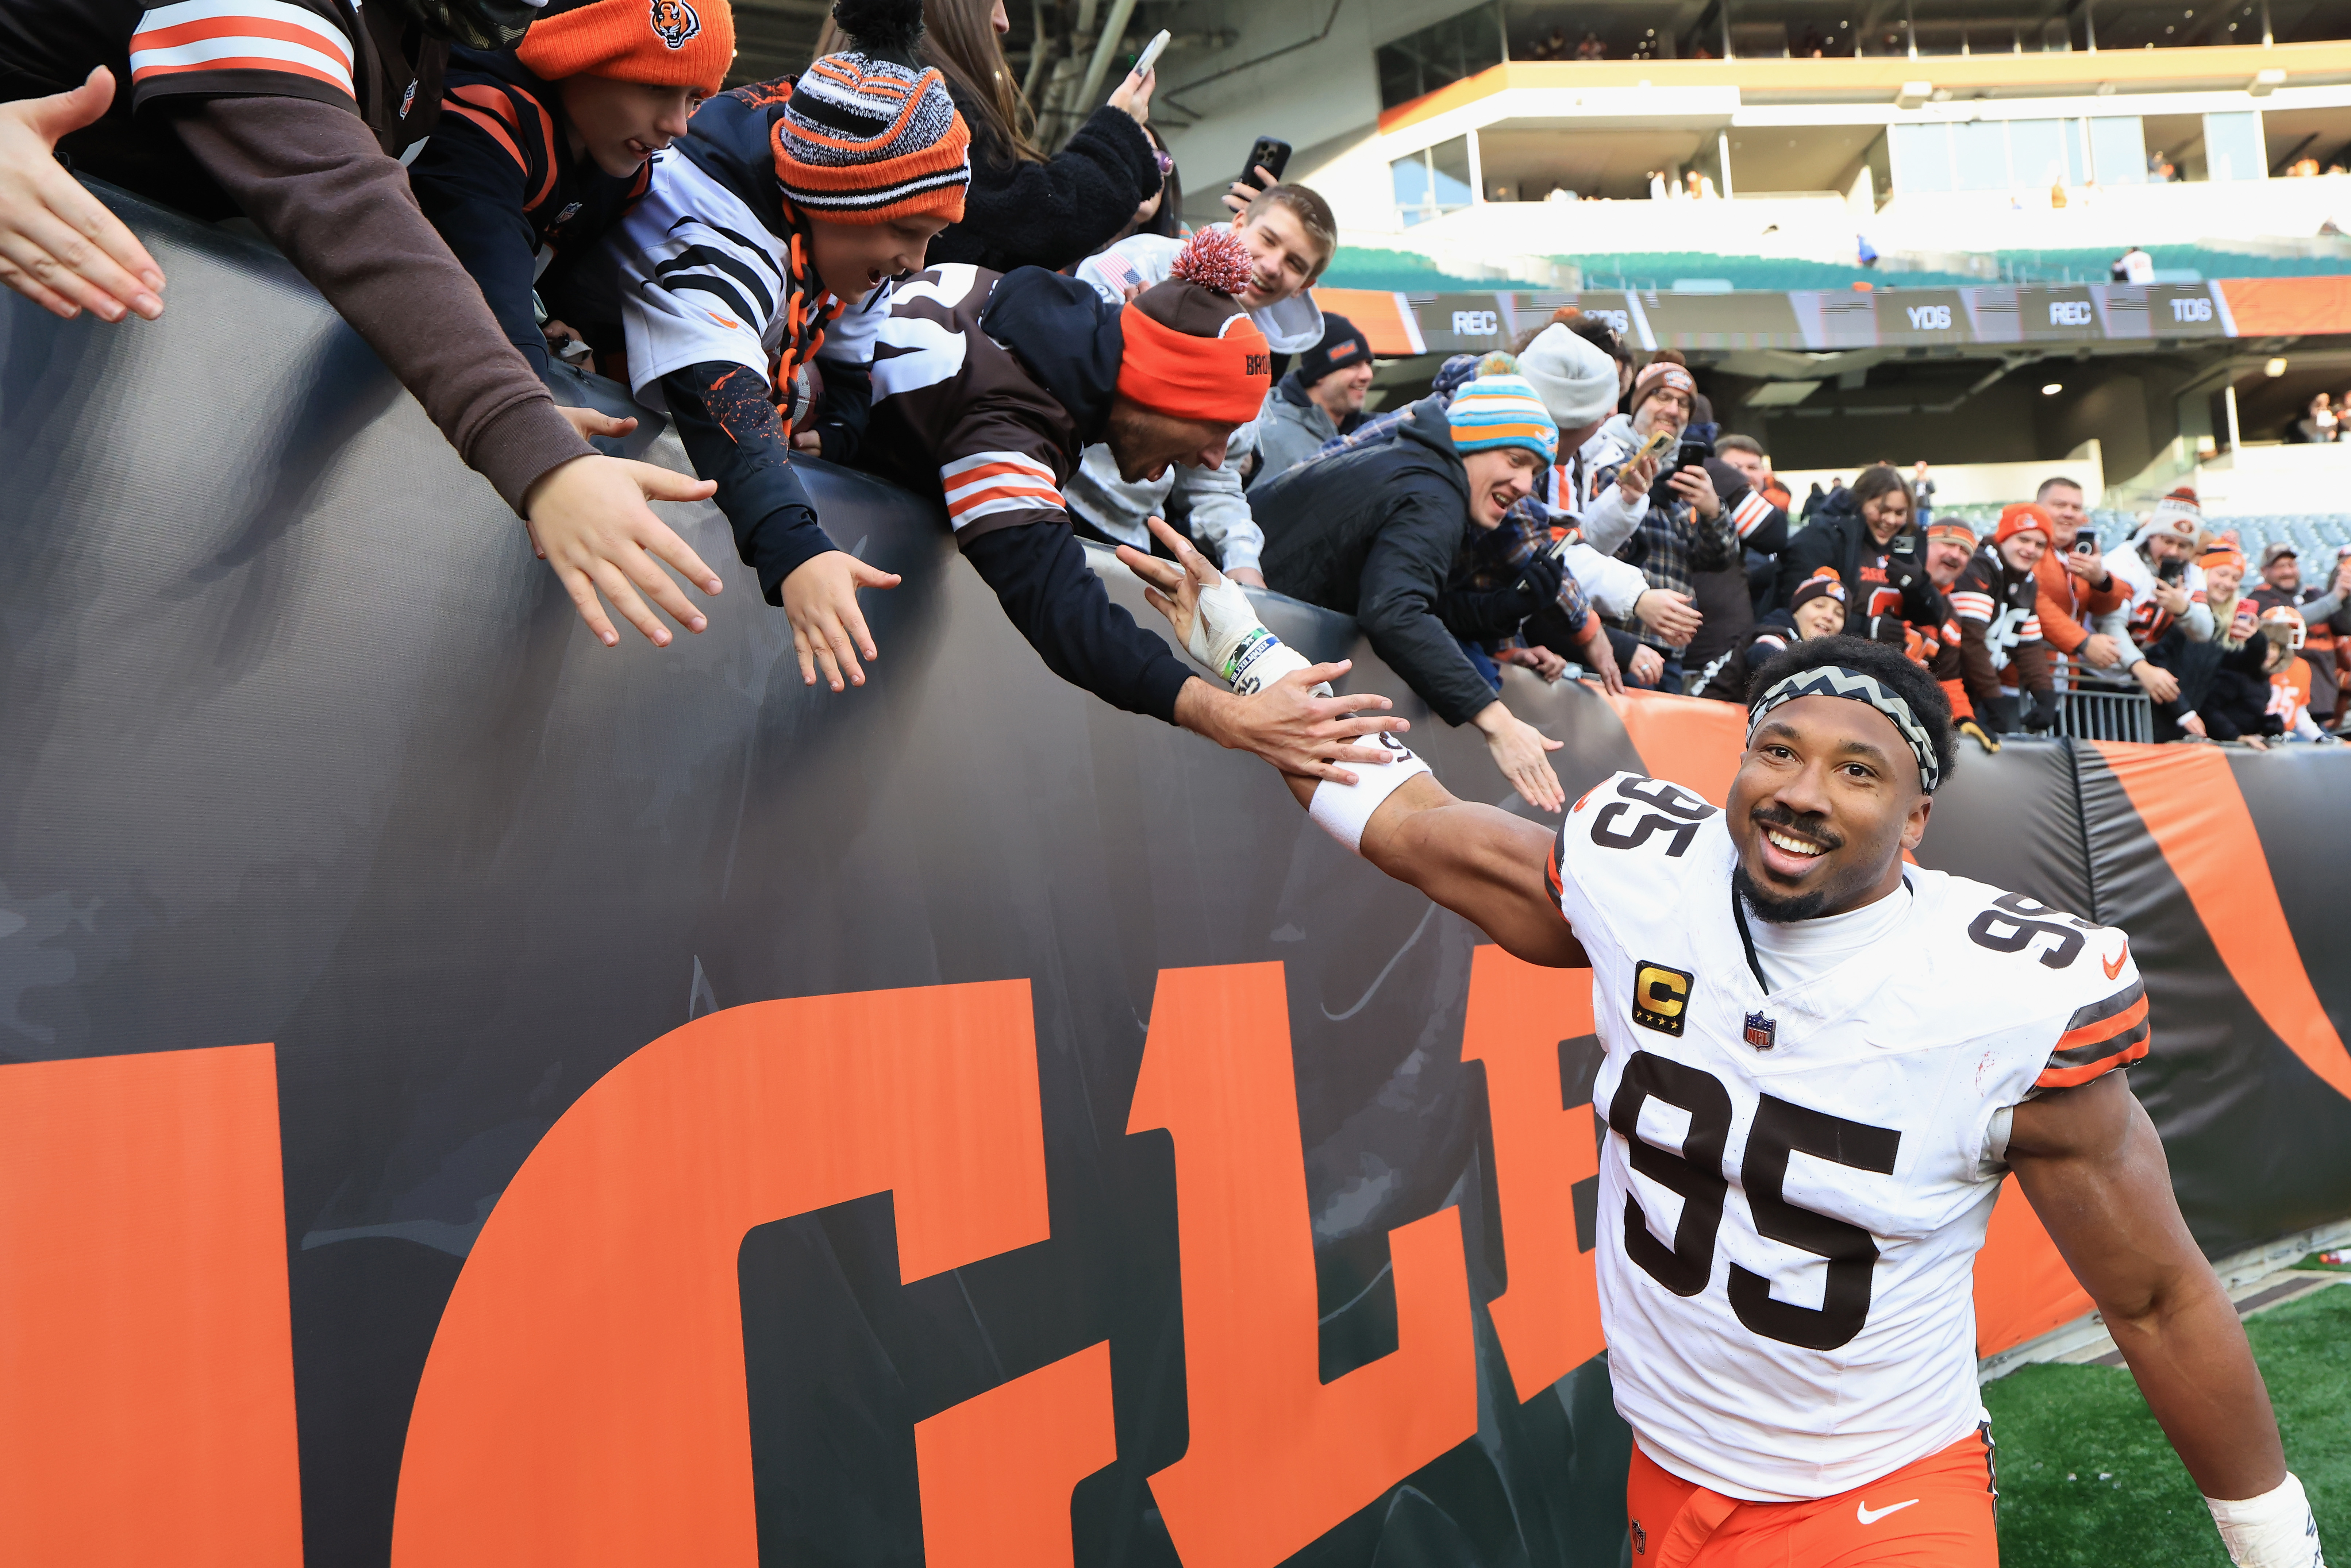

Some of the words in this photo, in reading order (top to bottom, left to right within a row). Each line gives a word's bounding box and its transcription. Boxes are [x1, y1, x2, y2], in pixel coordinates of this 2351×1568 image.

[1452, 311, 1497, 335] REC
[1906, 305, 1951, 329] YDS
[2049, 301, 2092, 325] REC
[2169, 298, 2212, 322] TDS
[1591, 777, 1718, 857] 95
[1637, 967, 1687, 1017] C
[1747, 1027, 1770, 1047] NFL
[1609, 1051, 1901, 1351] 95
